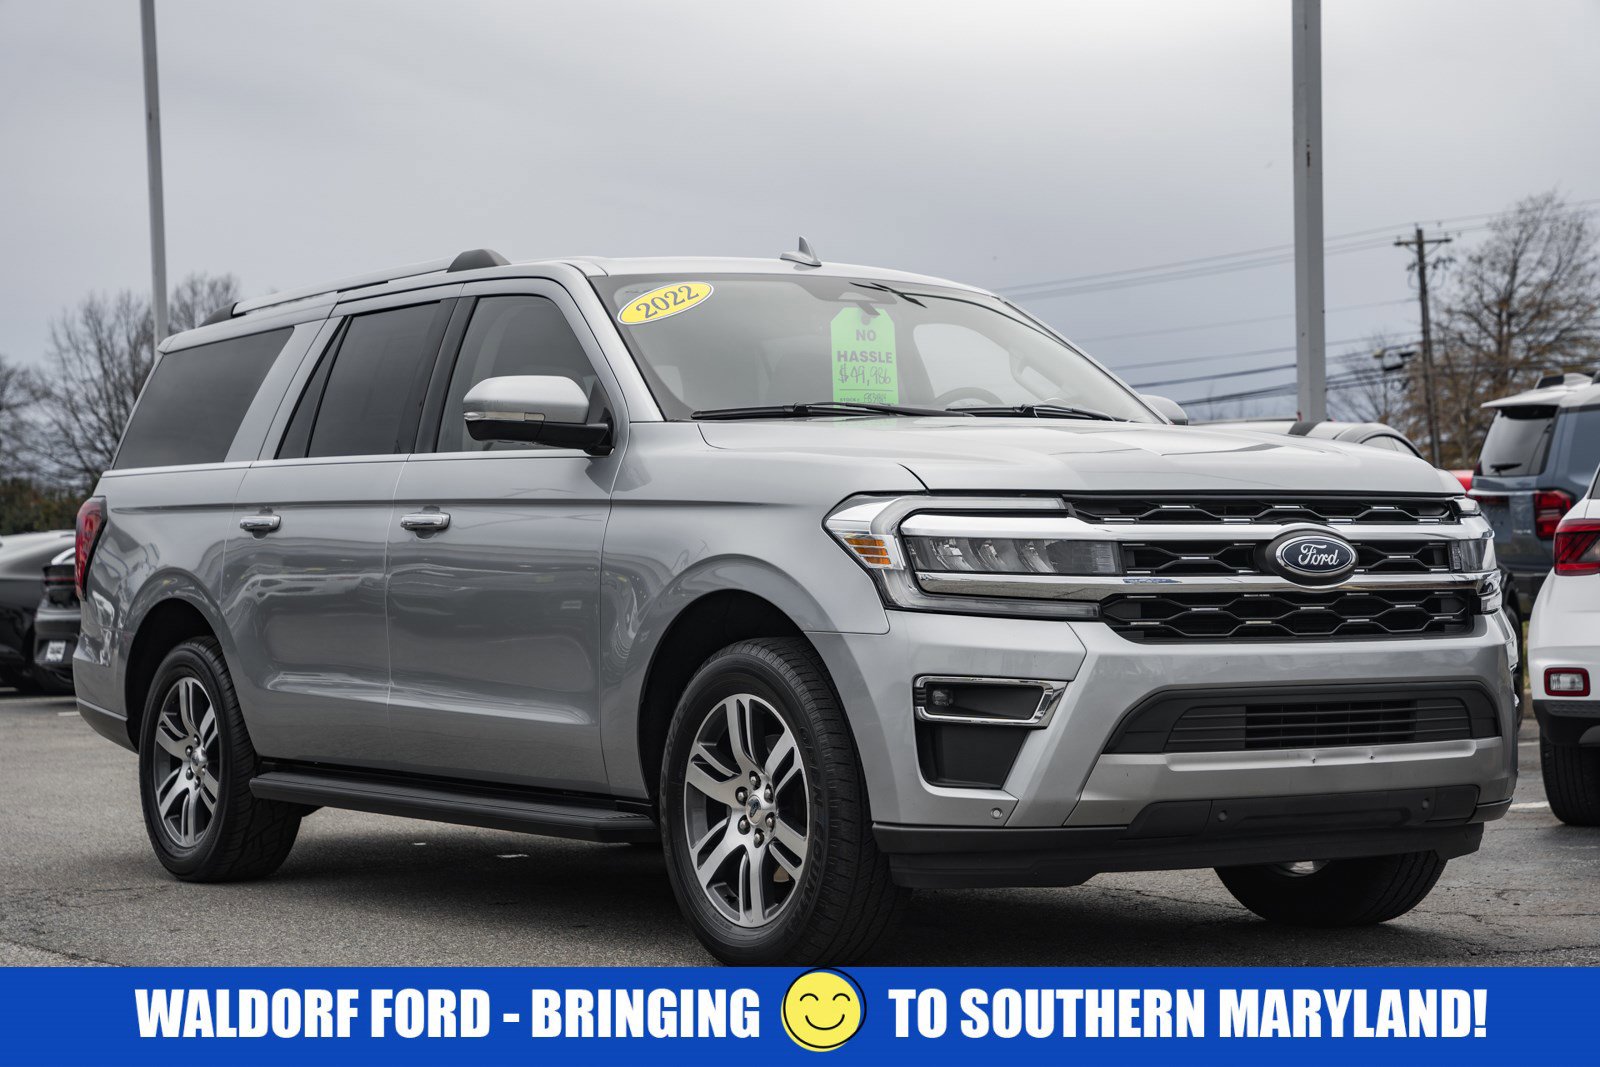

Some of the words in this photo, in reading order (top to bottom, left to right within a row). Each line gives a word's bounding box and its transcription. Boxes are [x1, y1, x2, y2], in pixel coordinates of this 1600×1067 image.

[635, 285, 700, 319] 2022
[856, 329, 877, 342] NO
[837, 350, 893, 364] HASSLE
[1298, 543, 1340, 566] Ford
